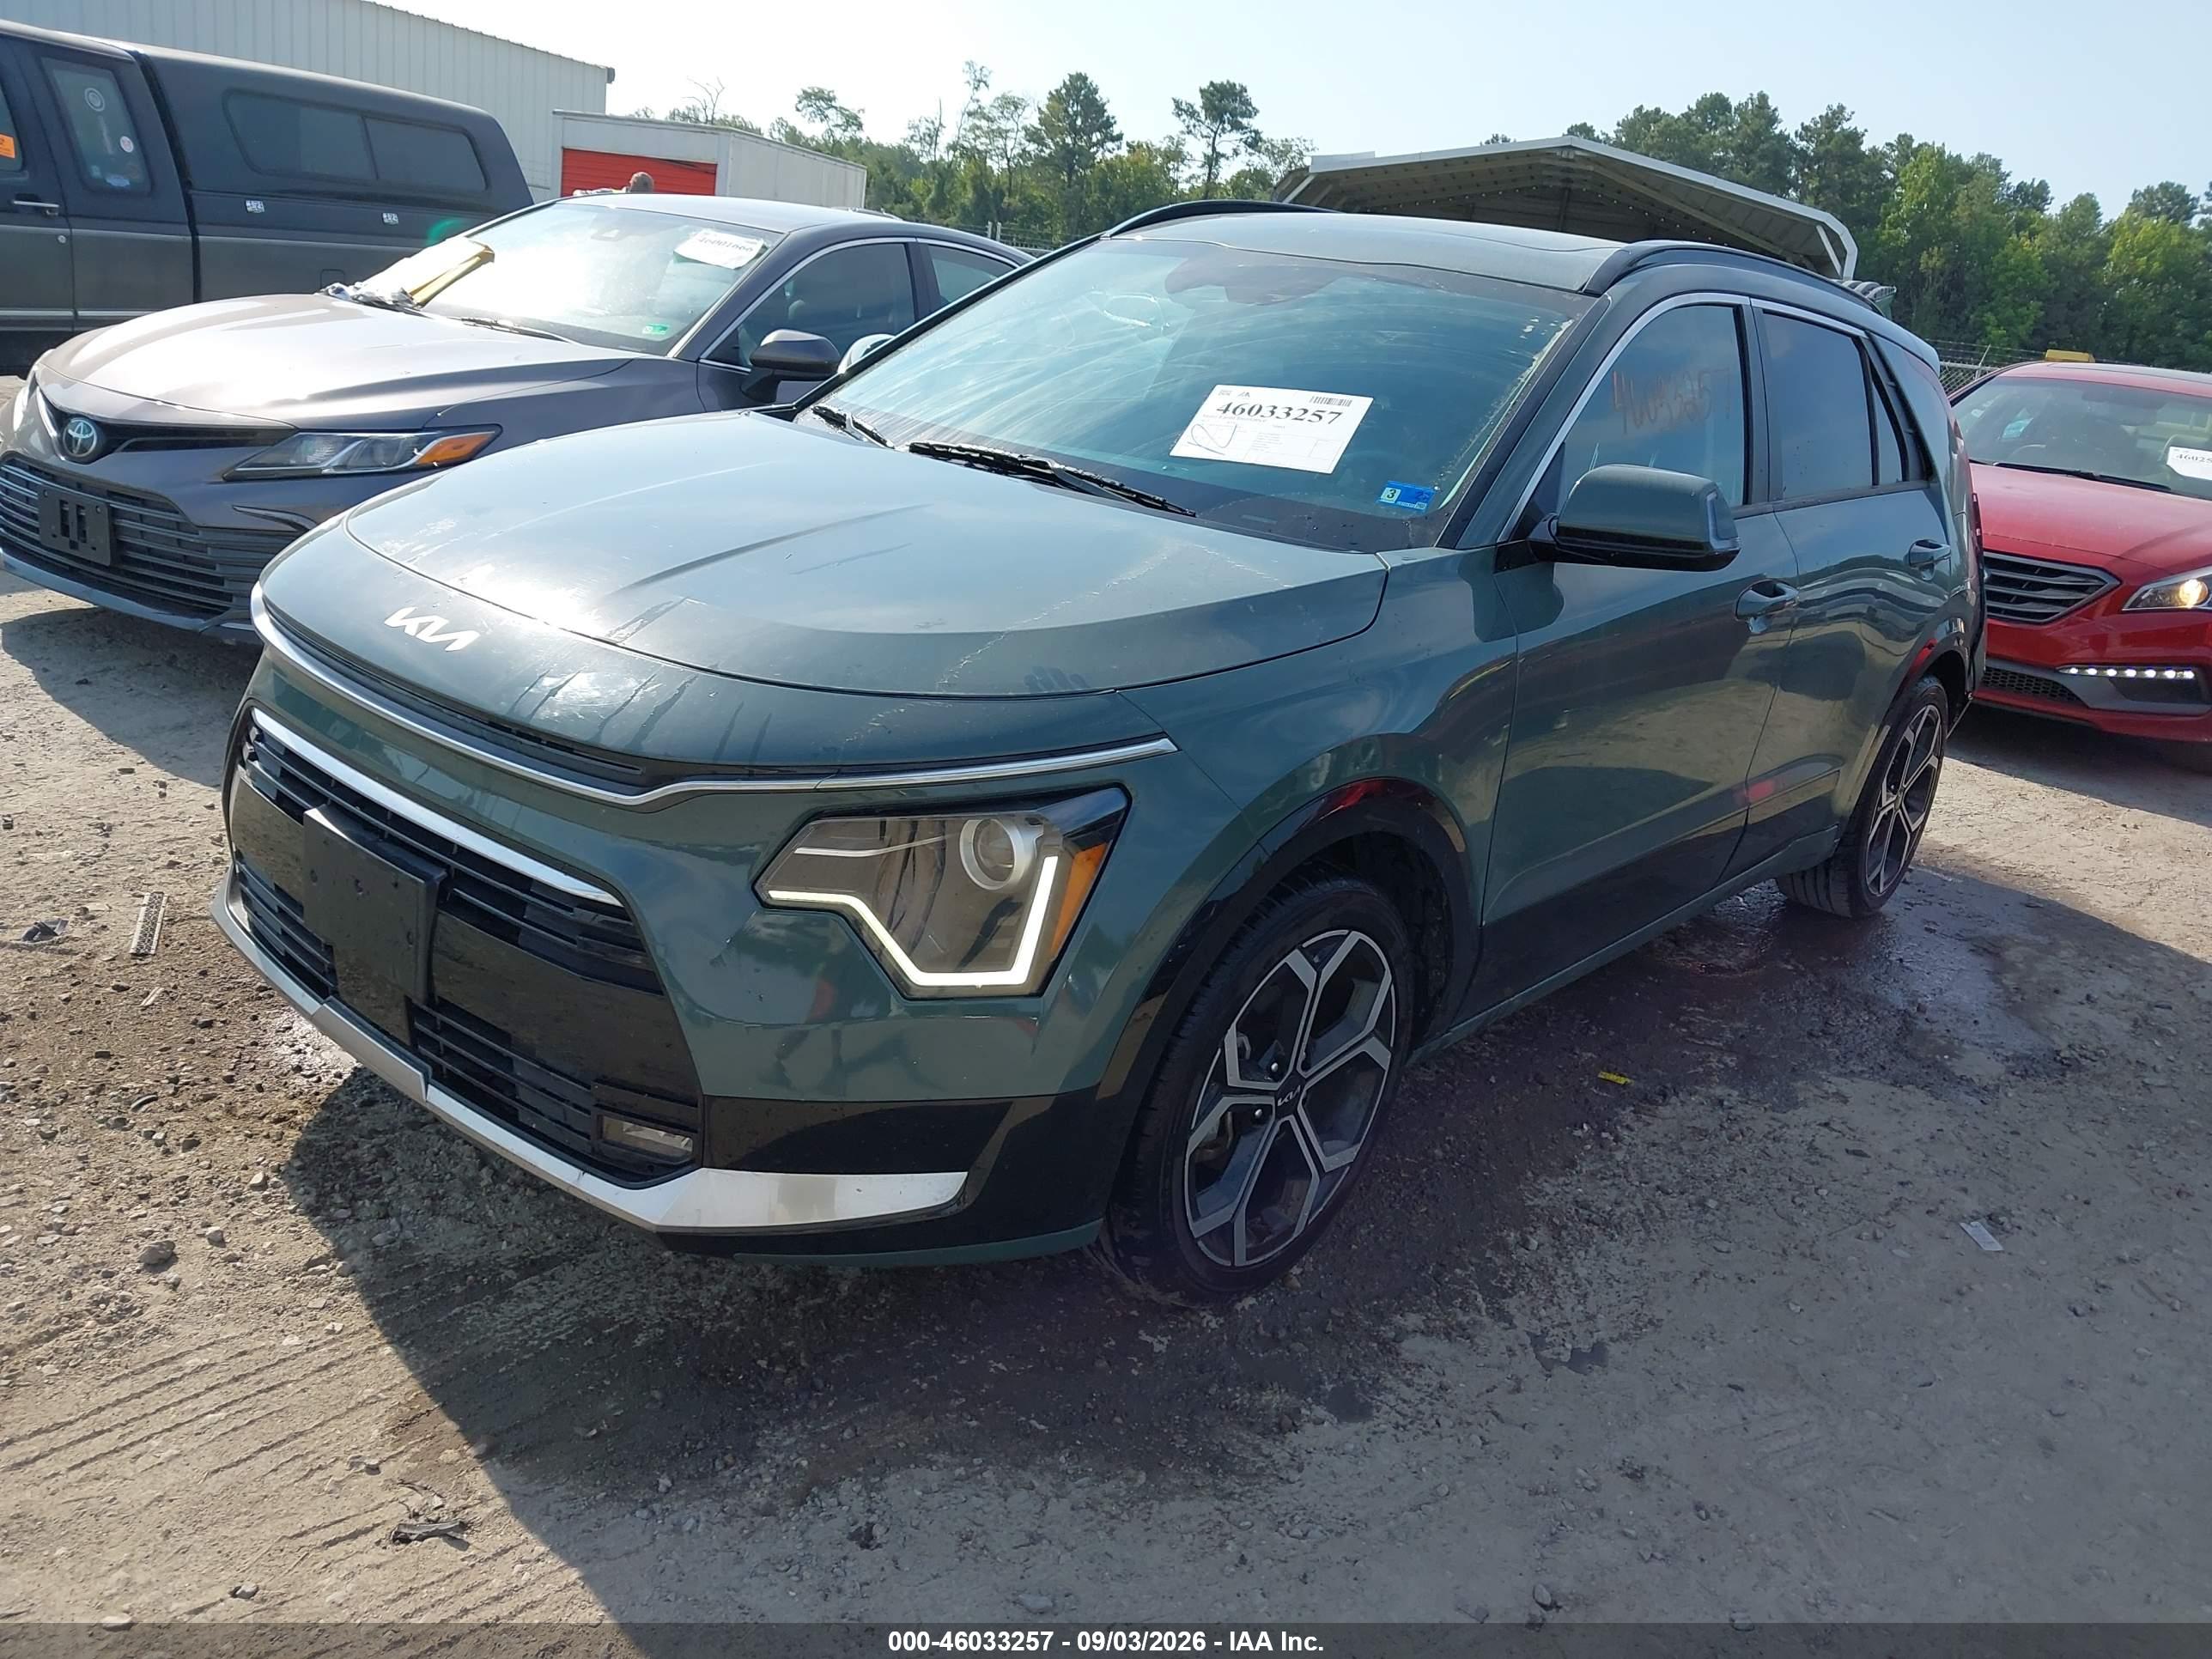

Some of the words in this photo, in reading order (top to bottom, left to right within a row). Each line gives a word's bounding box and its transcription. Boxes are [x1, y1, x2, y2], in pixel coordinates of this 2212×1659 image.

[1216, 402, 1342, 424] 46033257
[1387, 489, 1396, 499] 3
[384, 606, 481, 652] KIA
